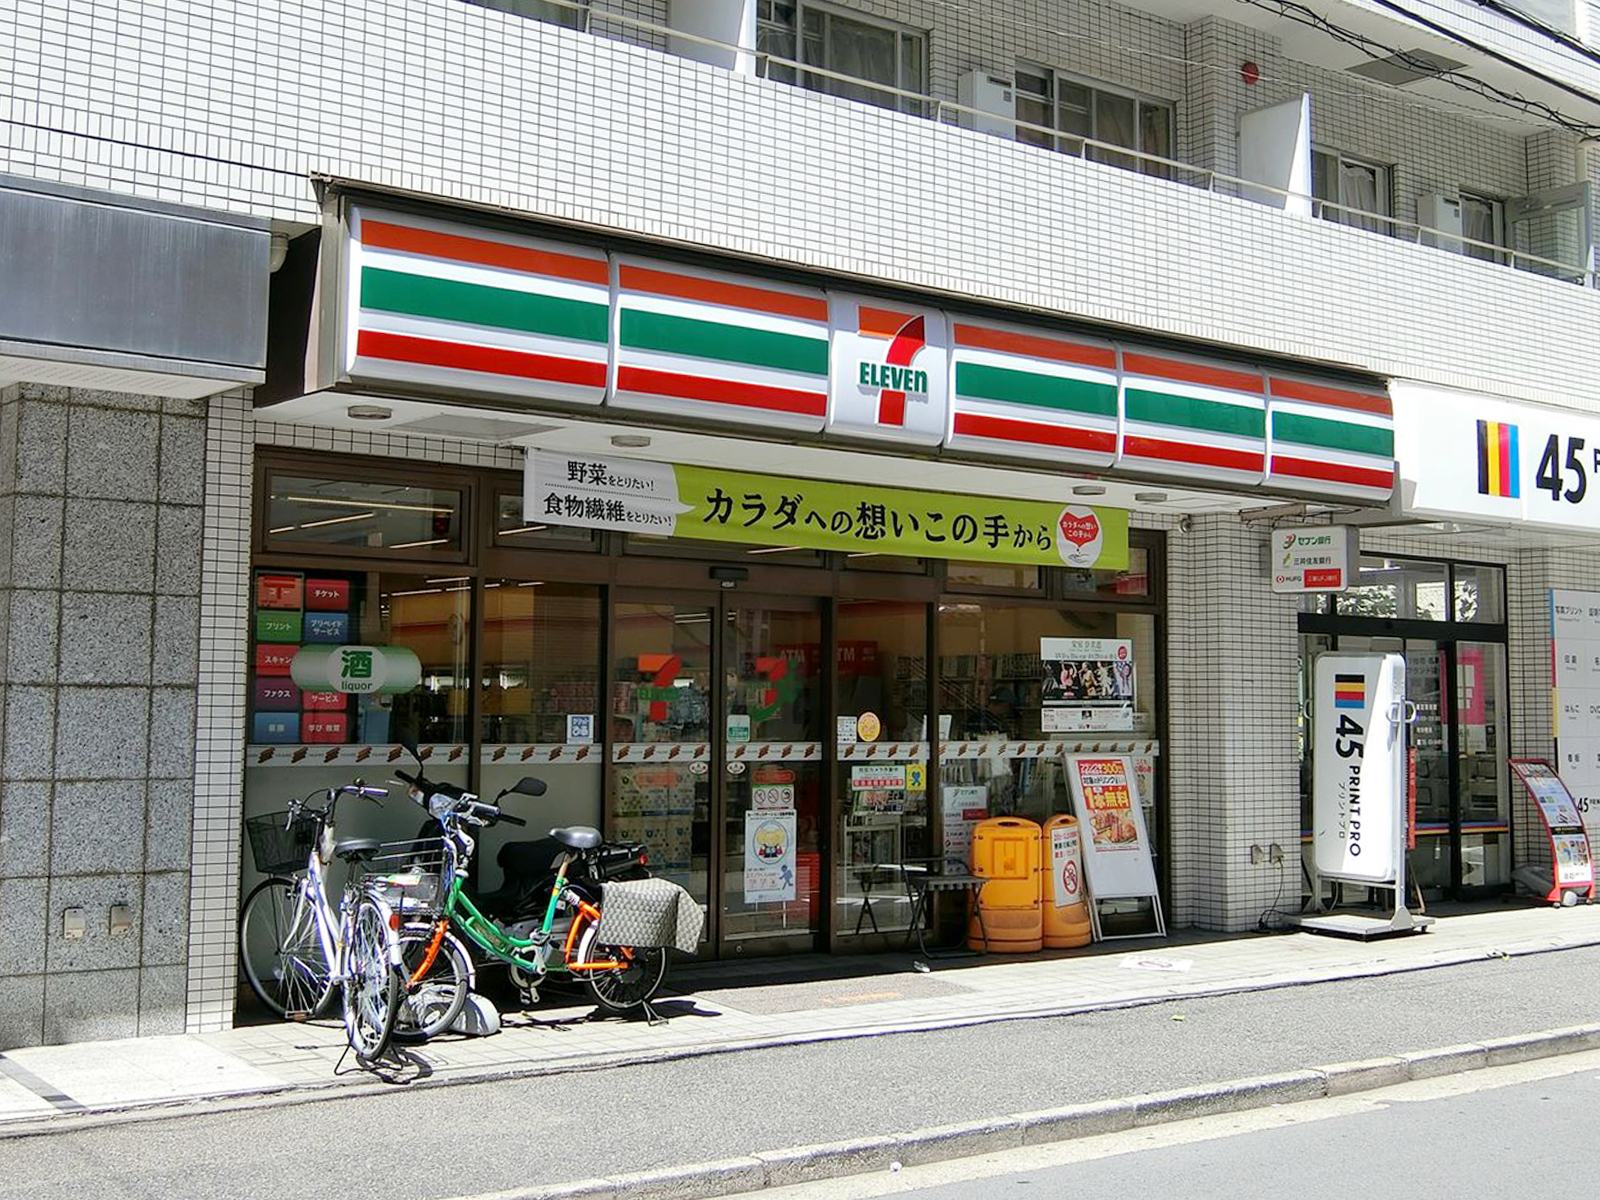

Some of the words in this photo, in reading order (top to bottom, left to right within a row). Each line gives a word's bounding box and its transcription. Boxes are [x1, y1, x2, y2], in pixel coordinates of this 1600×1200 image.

[1535, 433, 1587, 504] 45
[703, 487, 1052, 551] カラダへの想いこの手から
[1298, 535, 1331, 546] セブン銀行
[1293, 556, 1332, 566] 三井住友銀行
[314, 589, 340, 598] チケット
[265, 622, 292, 631] プリント
[313, 628, 340, 636] サービス
[341, 650, 373, 678] 酒
[341, 680, 373, 691] liquor
[311, 695, 339, 703] サービス
[1335, 714, 1365, 758] 45
[1349, 765, 1362, 816] PRINT
[1337, 782, 1348, 839] プリントプロ
[1577, 797, 1589, 813] 45
[1349, 821, 1362, 857] PRO
